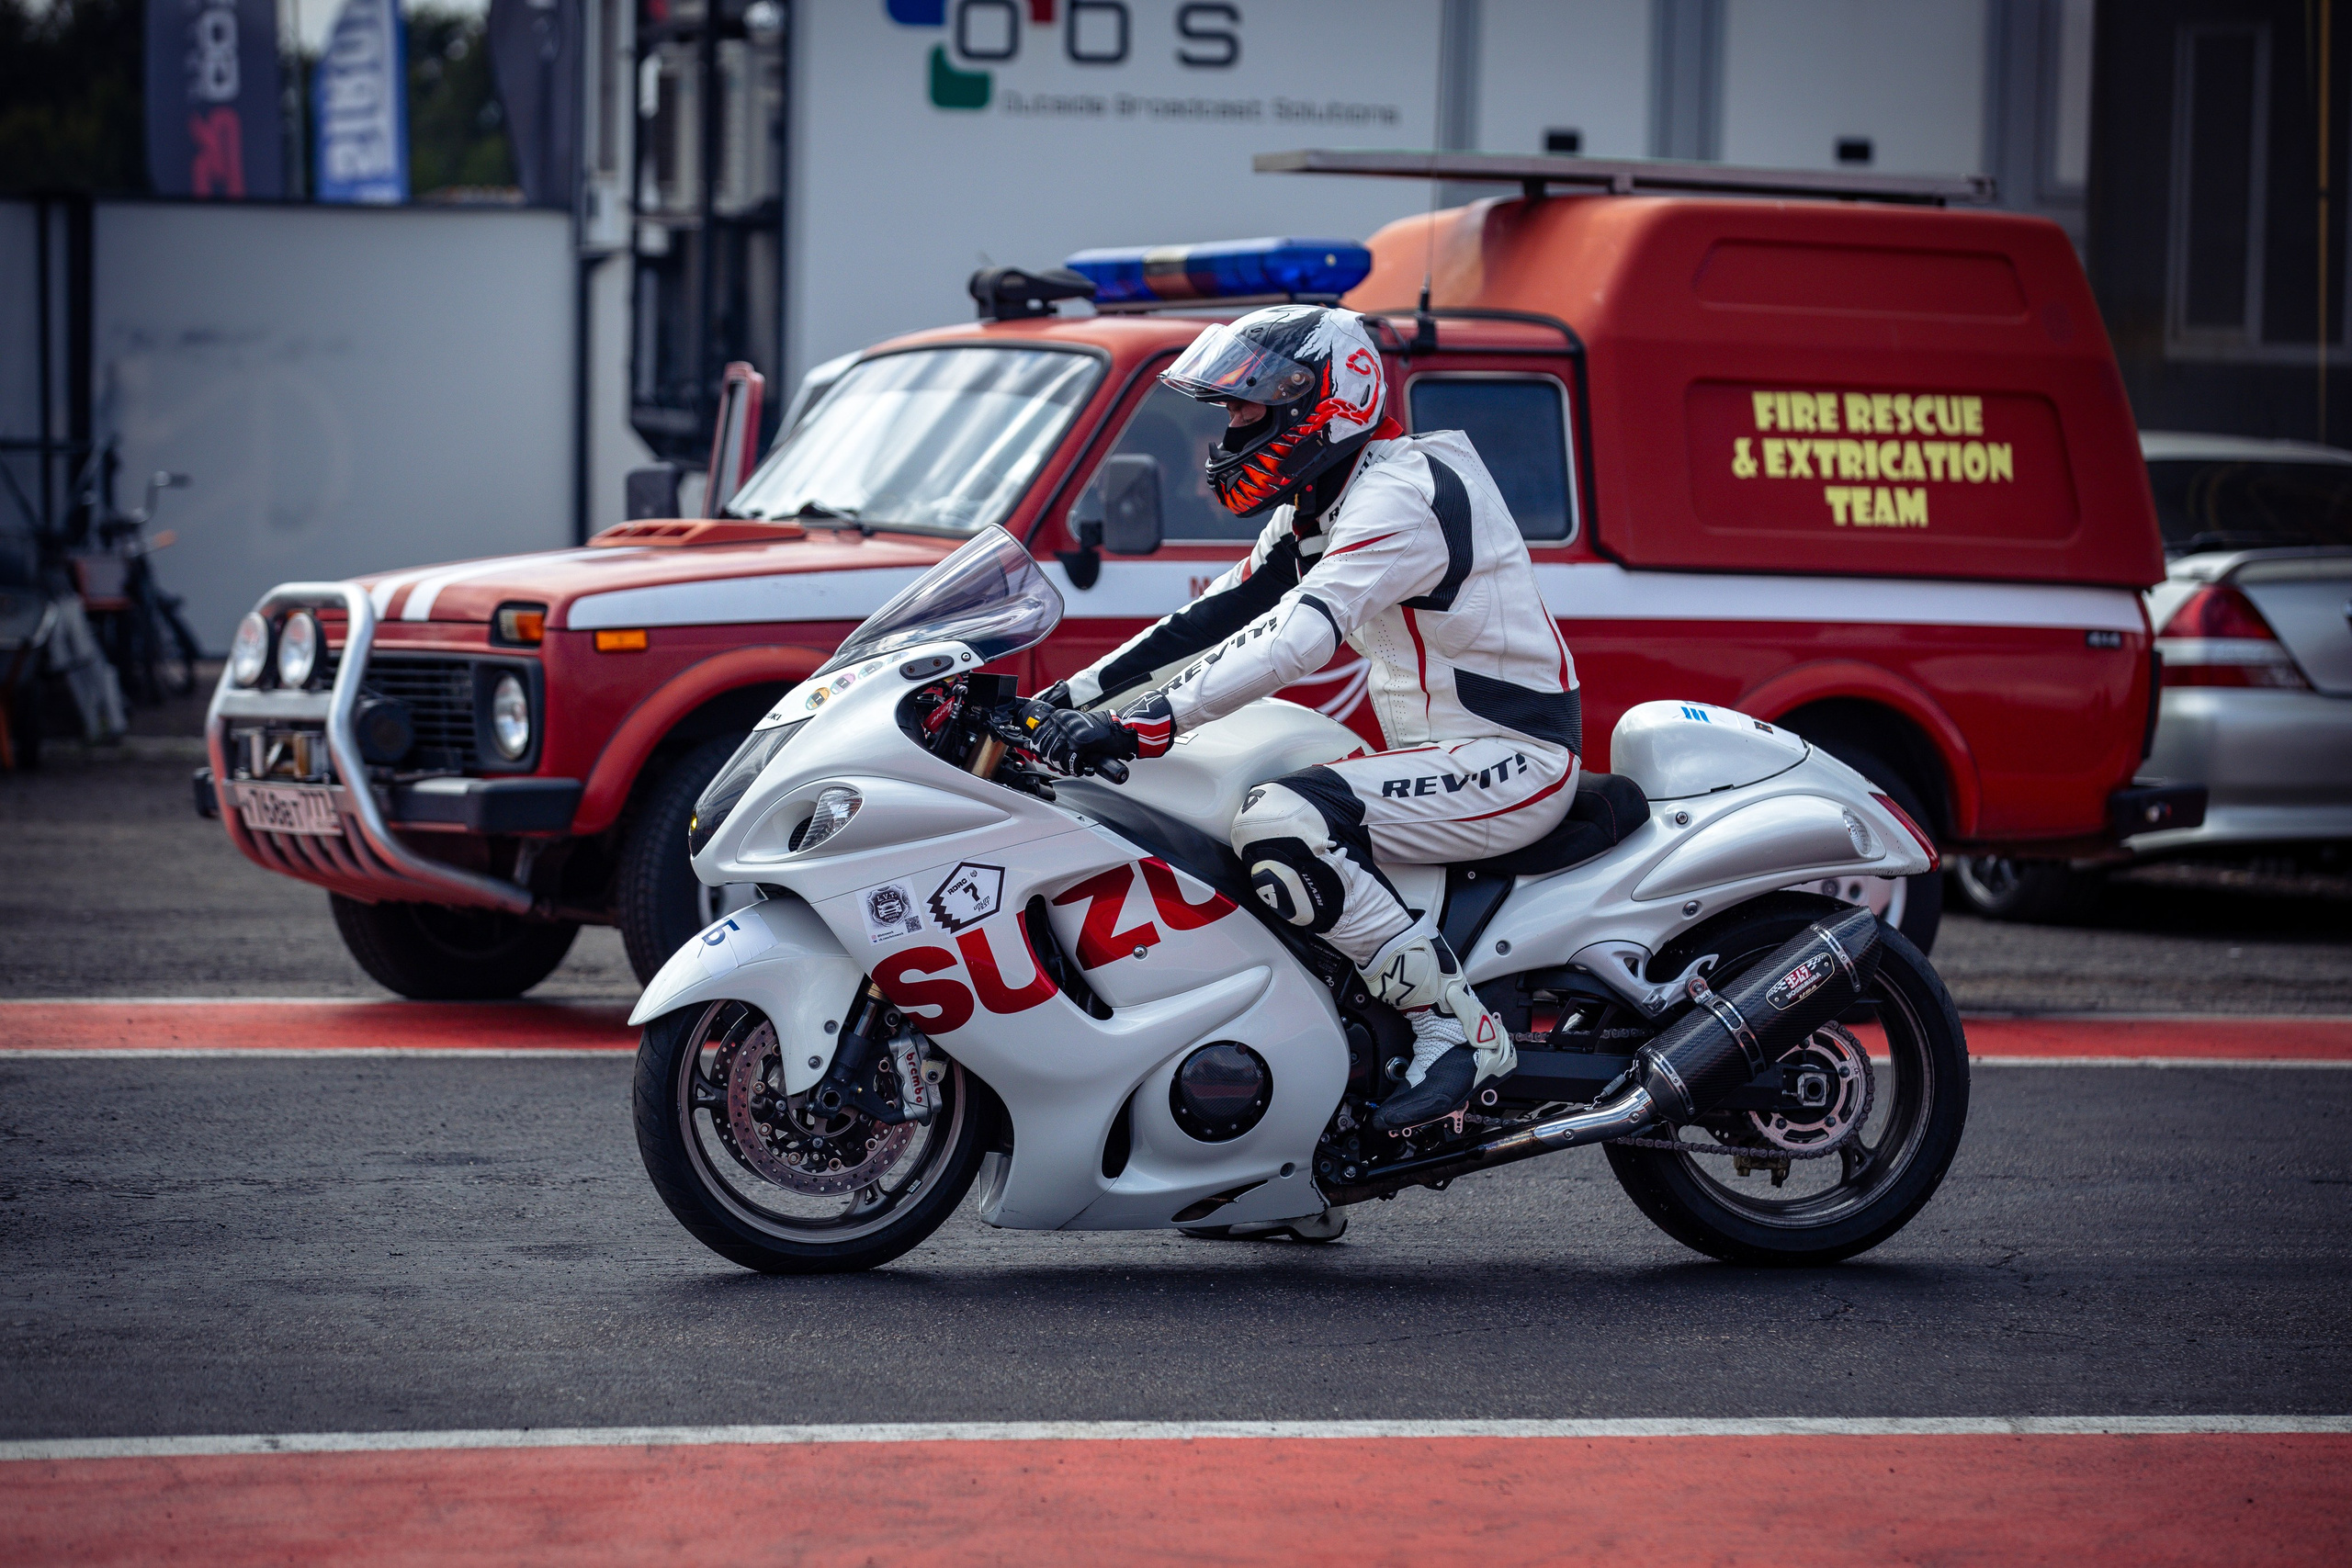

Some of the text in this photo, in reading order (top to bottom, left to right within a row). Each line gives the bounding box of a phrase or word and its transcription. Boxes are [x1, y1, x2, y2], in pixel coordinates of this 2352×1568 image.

[1751, 390, 1984, 436] FIRE RESCUE
[1732, 437, 2014, 483] & EXTRICATION
[1824, 485, 1929, 528] TEAM
[1160, 616, 1278, 695] REV'IT!
[1382, 752, 1528, 798] REV'IT!
[1785, 971, 1822, 1000] YOSHIMURA
[906, 1052, 924, 1103] brembo
